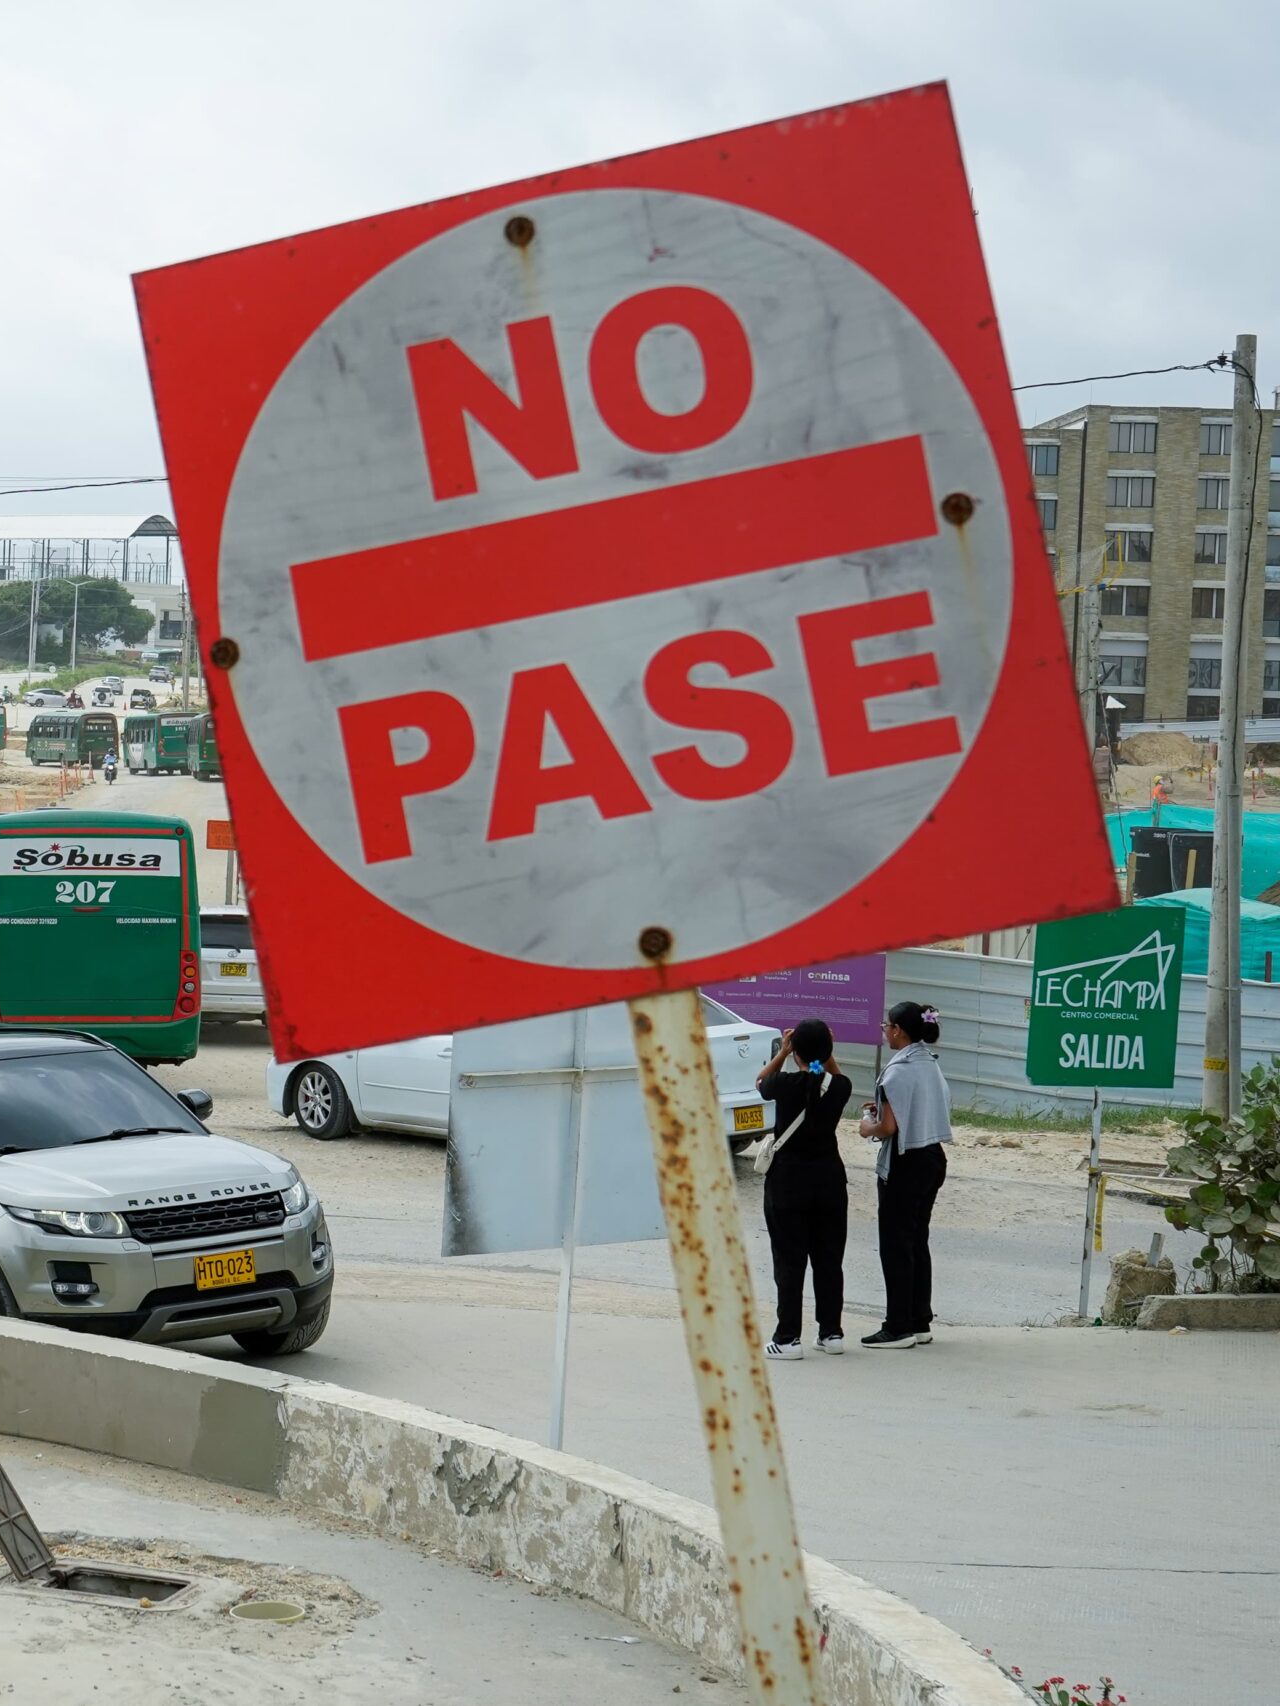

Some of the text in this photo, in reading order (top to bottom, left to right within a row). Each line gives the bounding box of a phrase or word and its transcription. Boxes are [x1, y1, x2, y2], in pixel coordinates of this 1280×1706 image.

[406, 285, 753, 502] NO
[337, 590, 963, 865] PASE
[13, 848, 162, 868] Sobusa
[55, 880, 117, 903] 207
[808, 971, 851, 982] coninsa
[1060, 1011, 1140, 1021] CENTRO COMERCIAL
[1059, 1033, 1145, 1070] SALIDA
[127, 1182, 271, 1207] RANGE ROVER
[197, 1255, 253, 1281] HTO-023
